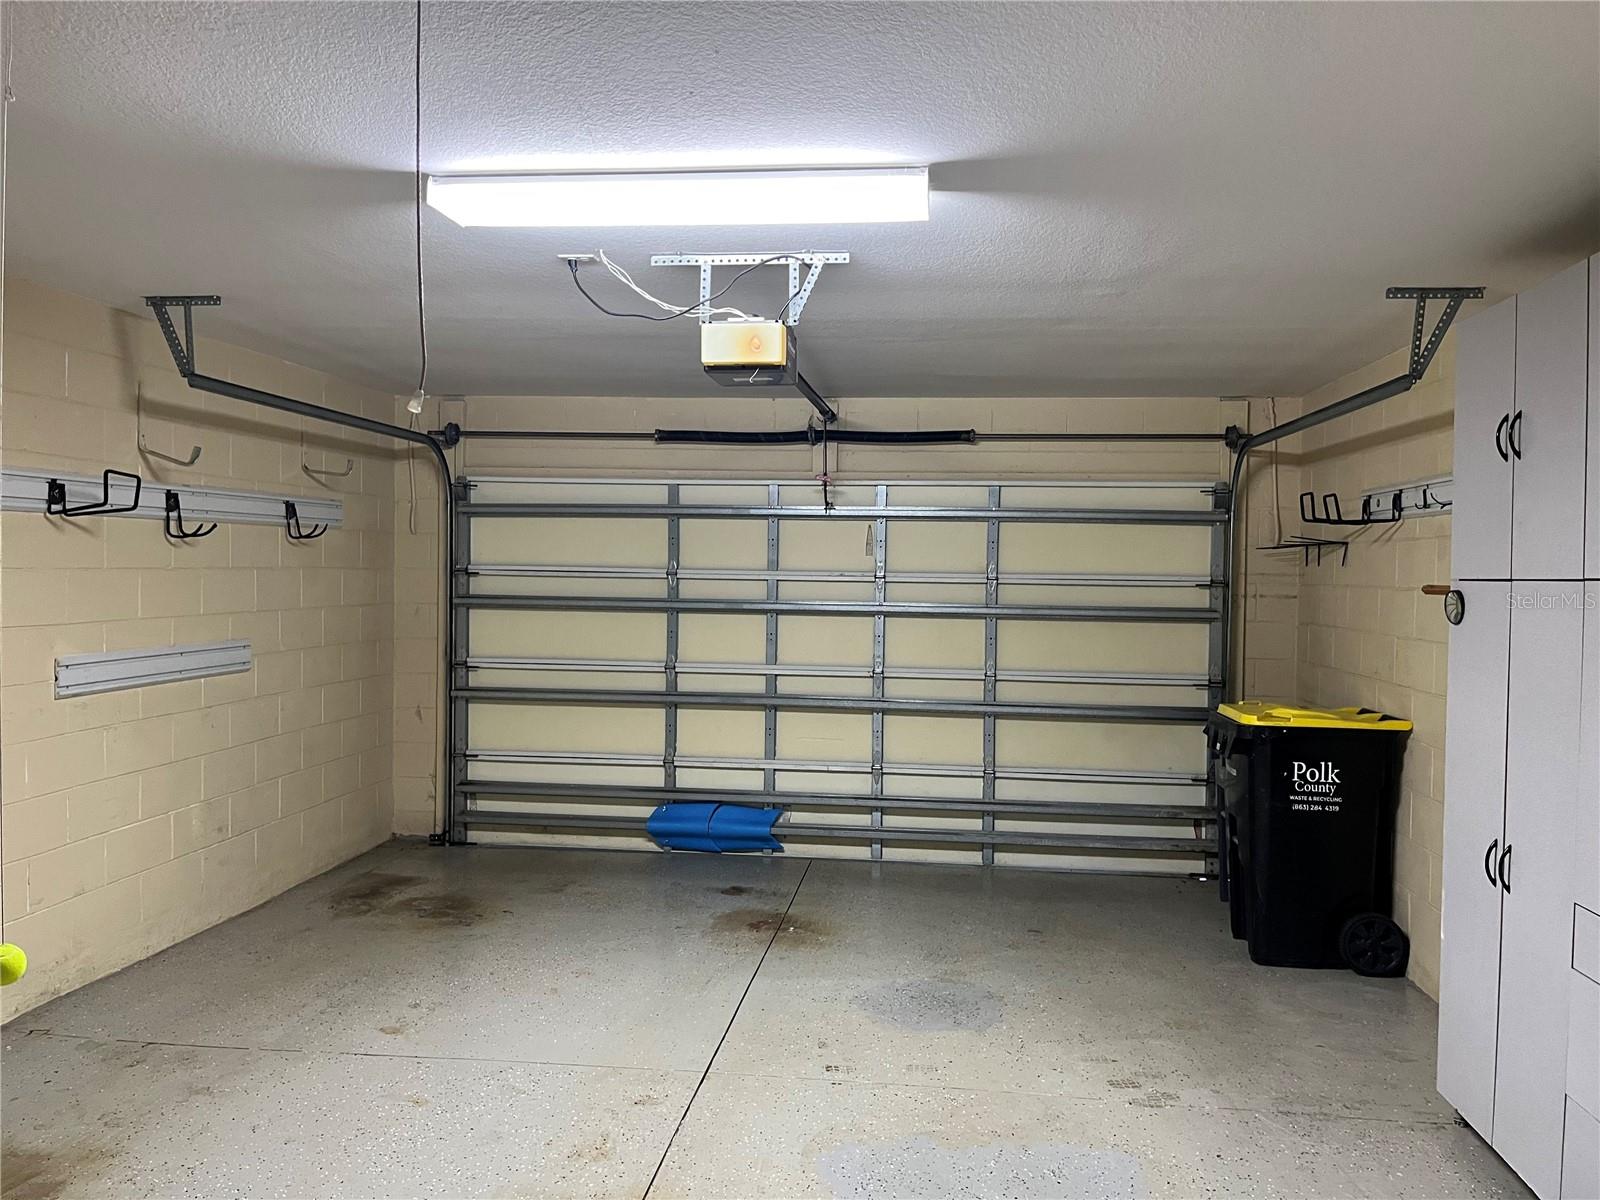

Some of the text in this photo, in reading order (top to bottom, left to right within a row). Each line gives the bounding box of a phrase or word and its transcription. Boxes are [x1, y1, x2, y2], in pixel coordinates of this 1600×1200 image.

[1292, 761, 1341, 783] Polk
[1295, 781, 1337, 796] County
[1292, 803, 1309, 811] (863)
[1325, 804, 1340, 812] 4319
